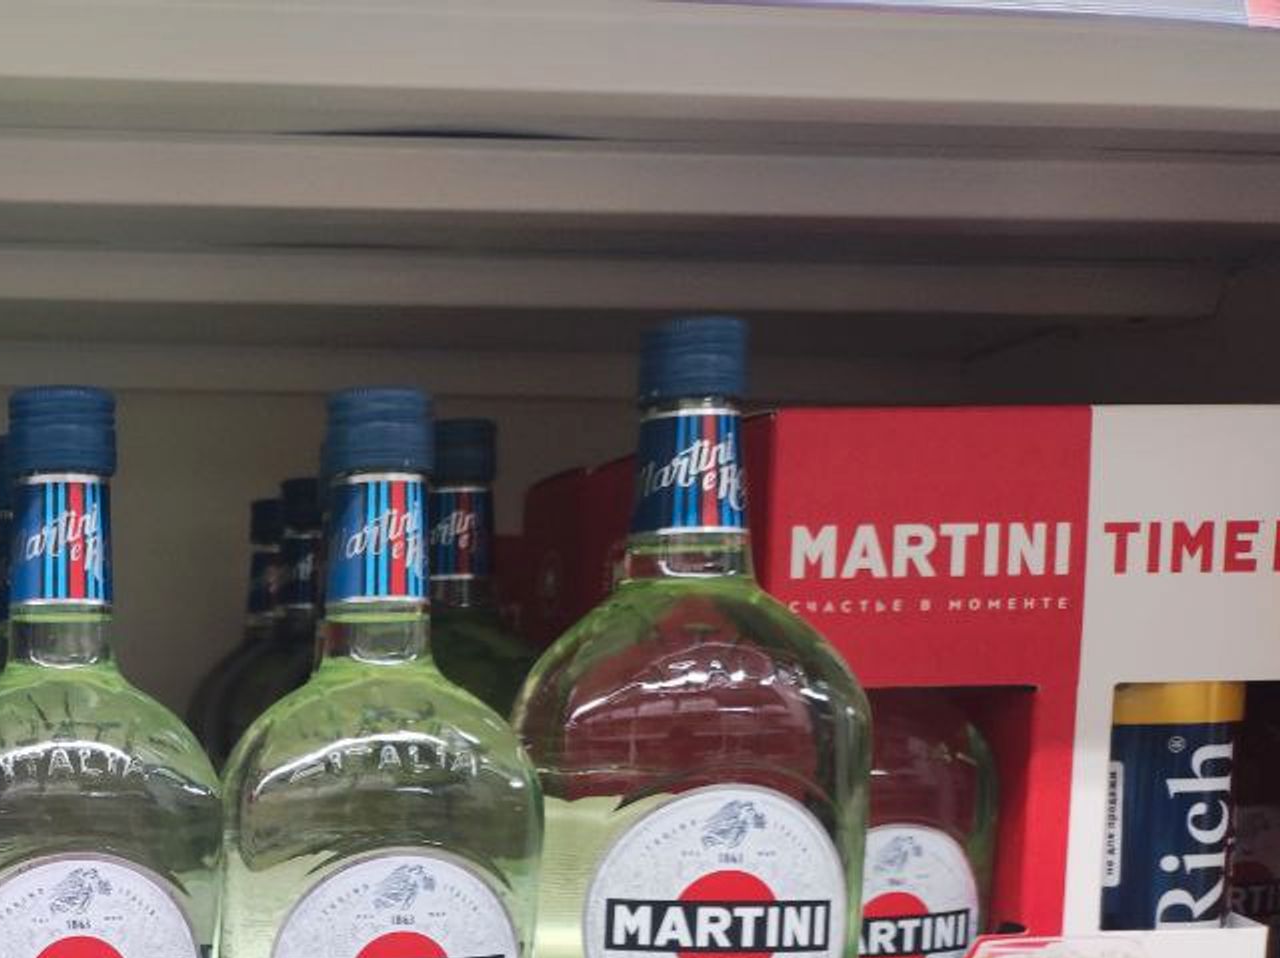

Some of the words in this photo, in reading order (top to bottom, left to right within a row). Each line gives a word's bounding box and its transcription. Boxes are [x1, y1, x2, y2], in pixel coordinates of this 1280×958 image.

[790, 522, 1072, 579] MARTINI
[788, 598, 903, 614] СЧАСТЬЕ
[921, 601, 932, 612] В
[948, 597, 1070, 611] МОМЕНТЕ
[611, 904, 826, 948] MARTINI
